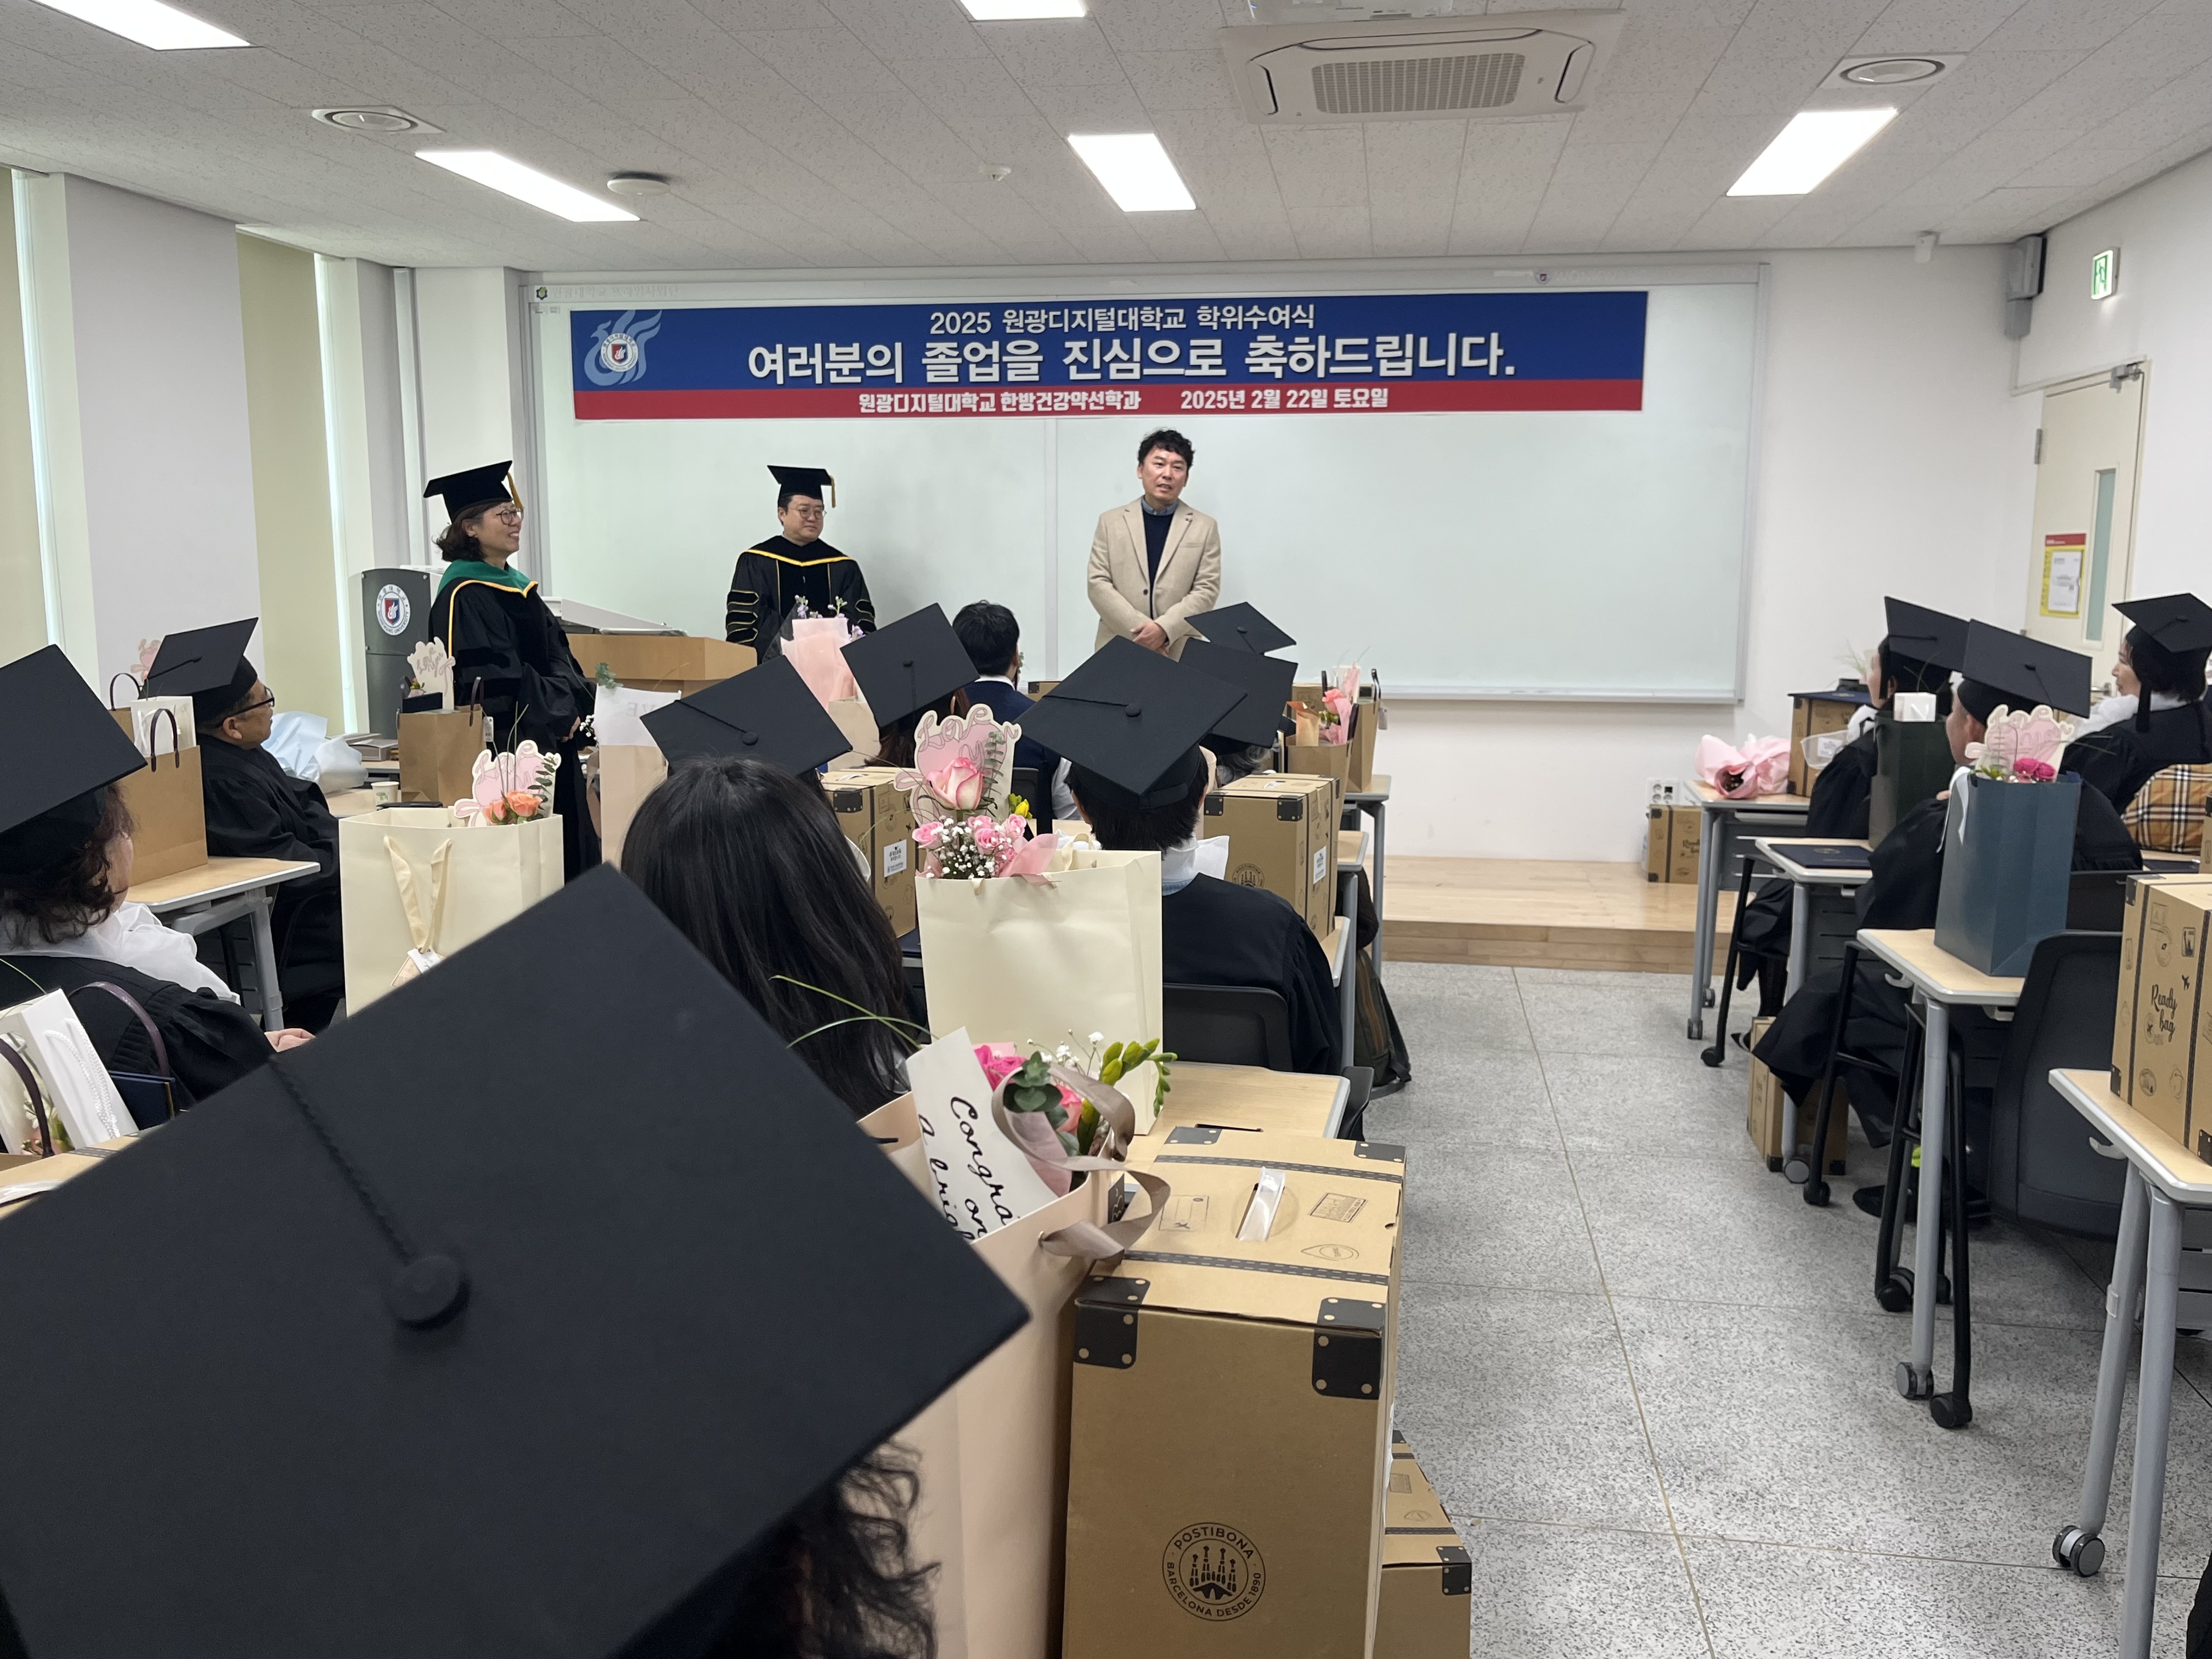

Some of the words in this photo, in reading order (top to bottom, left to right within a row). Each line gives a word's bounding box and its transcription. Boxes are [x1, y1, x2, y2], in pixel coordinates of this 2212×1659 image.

[930, 312, 991, 334] 2025
[1002, 307, 1186, 334] 원광디지털대학교
[1197, 304, 1314, 330] 학위수여식
[748, 342, 903, 385] 여러분의
[922, 340, 1043, 383] 졸업을
[1062, 337, 1227, 381] 진심으로
[1245, 332, 1515, 379] 축하드립니다.
[859, 392, 996, 413] 원광디지털대학교
[1001, 389, 1142, 411] 한방건강약선학과
[1181, 390, 1245, 410] 2025년
[1251, 389, 1280, 409] 2월
[1286, 388, 1328, 409] 22일
[1333, 387, 1389, 408] 토요일
[2151, 984, 2178, 1019] Ready
[2159, 1009, 2176, 1043] bag
[950, 1096, 1020, 1227] Congra
[1173, 1526, 1254, 1559] POSTIBONA
[1166, 1562, 1212, 1616] BARCELONA
[1216, 1596, 1252, 1617] DESDE
[1249, 1572, 1261, 1596] 1890
